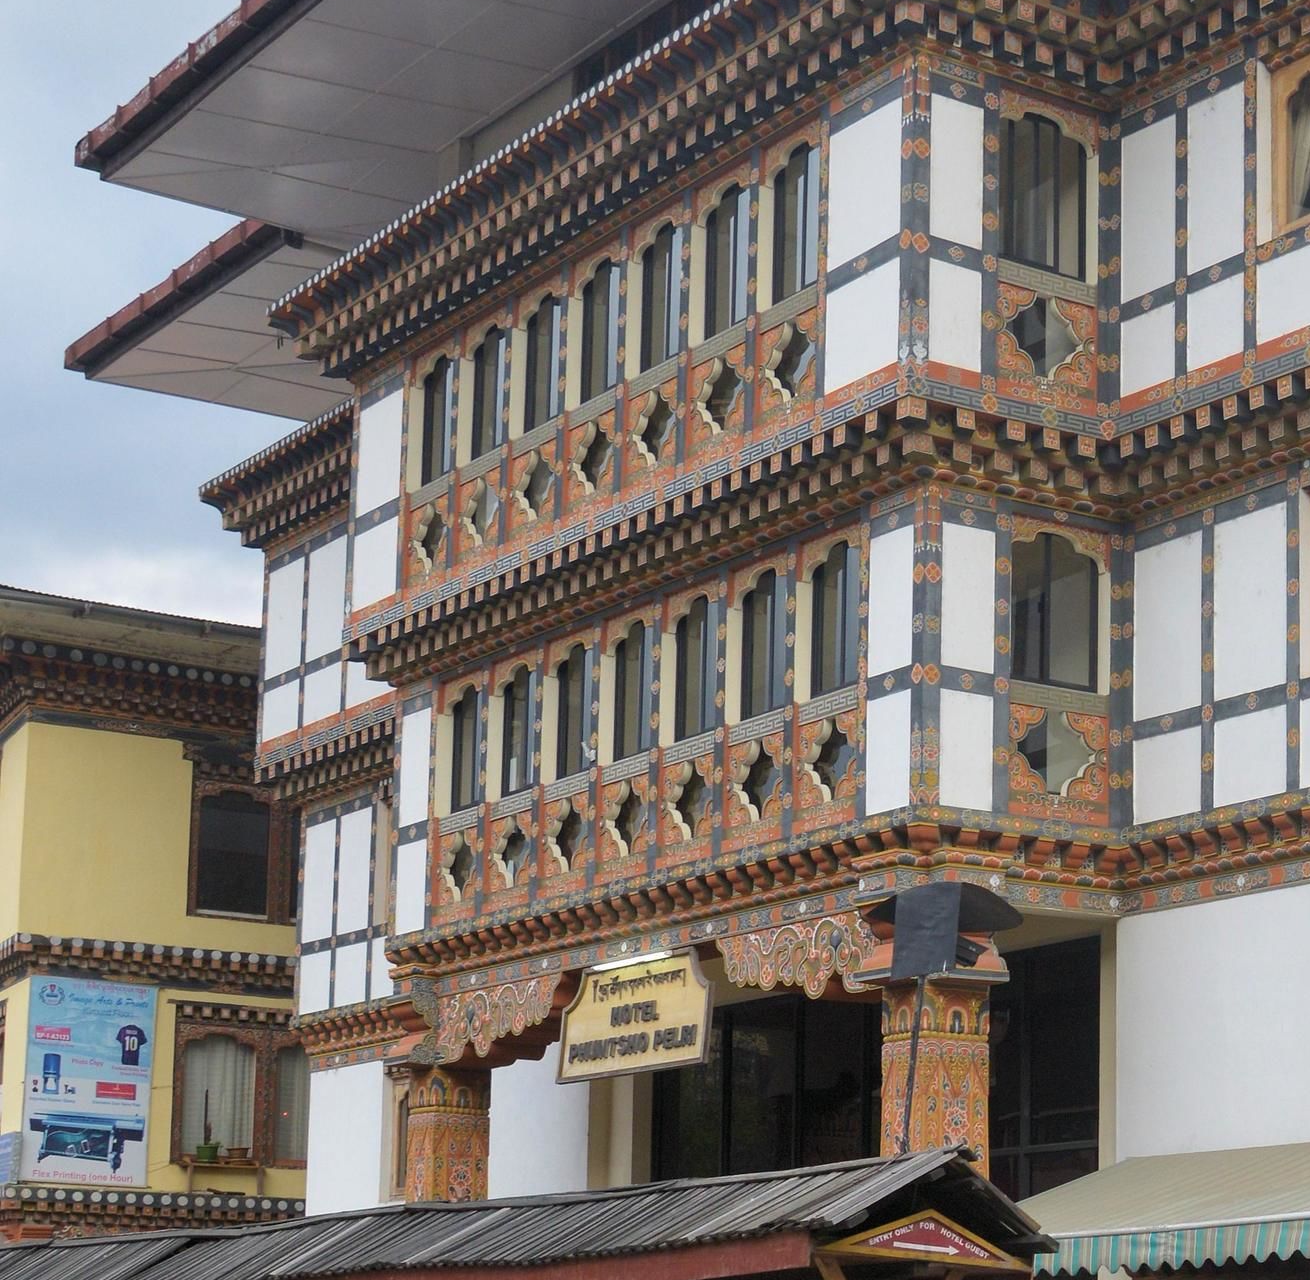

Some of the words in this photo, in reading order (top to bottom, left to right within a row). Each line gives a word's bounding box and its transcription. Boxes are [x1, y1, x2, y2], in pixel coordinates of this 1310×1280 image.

[610, 1000, 660, 1027] HOTEL
[124, 1035, 138, 1051] 10
[568, 1031, 649, 1064] PHUNTSHO
[653, 1024, 698, 1052] PELRI
[32, 1169, 50, 1178] Flex
[53, 1171, 87, 1181] Printing
[89, 1173, 108, 1181] (one
[110, 1174, 134, 1183] Hour)
[869, 1231, 893, 1246] ENTRY
[894, 1224, 914, 1237] ONLY
[920, 1222, 935, 1231] FOR
[940, 1227, 965, 1246] HOTEL
[965, 1242, 990, 1260] GUEST
